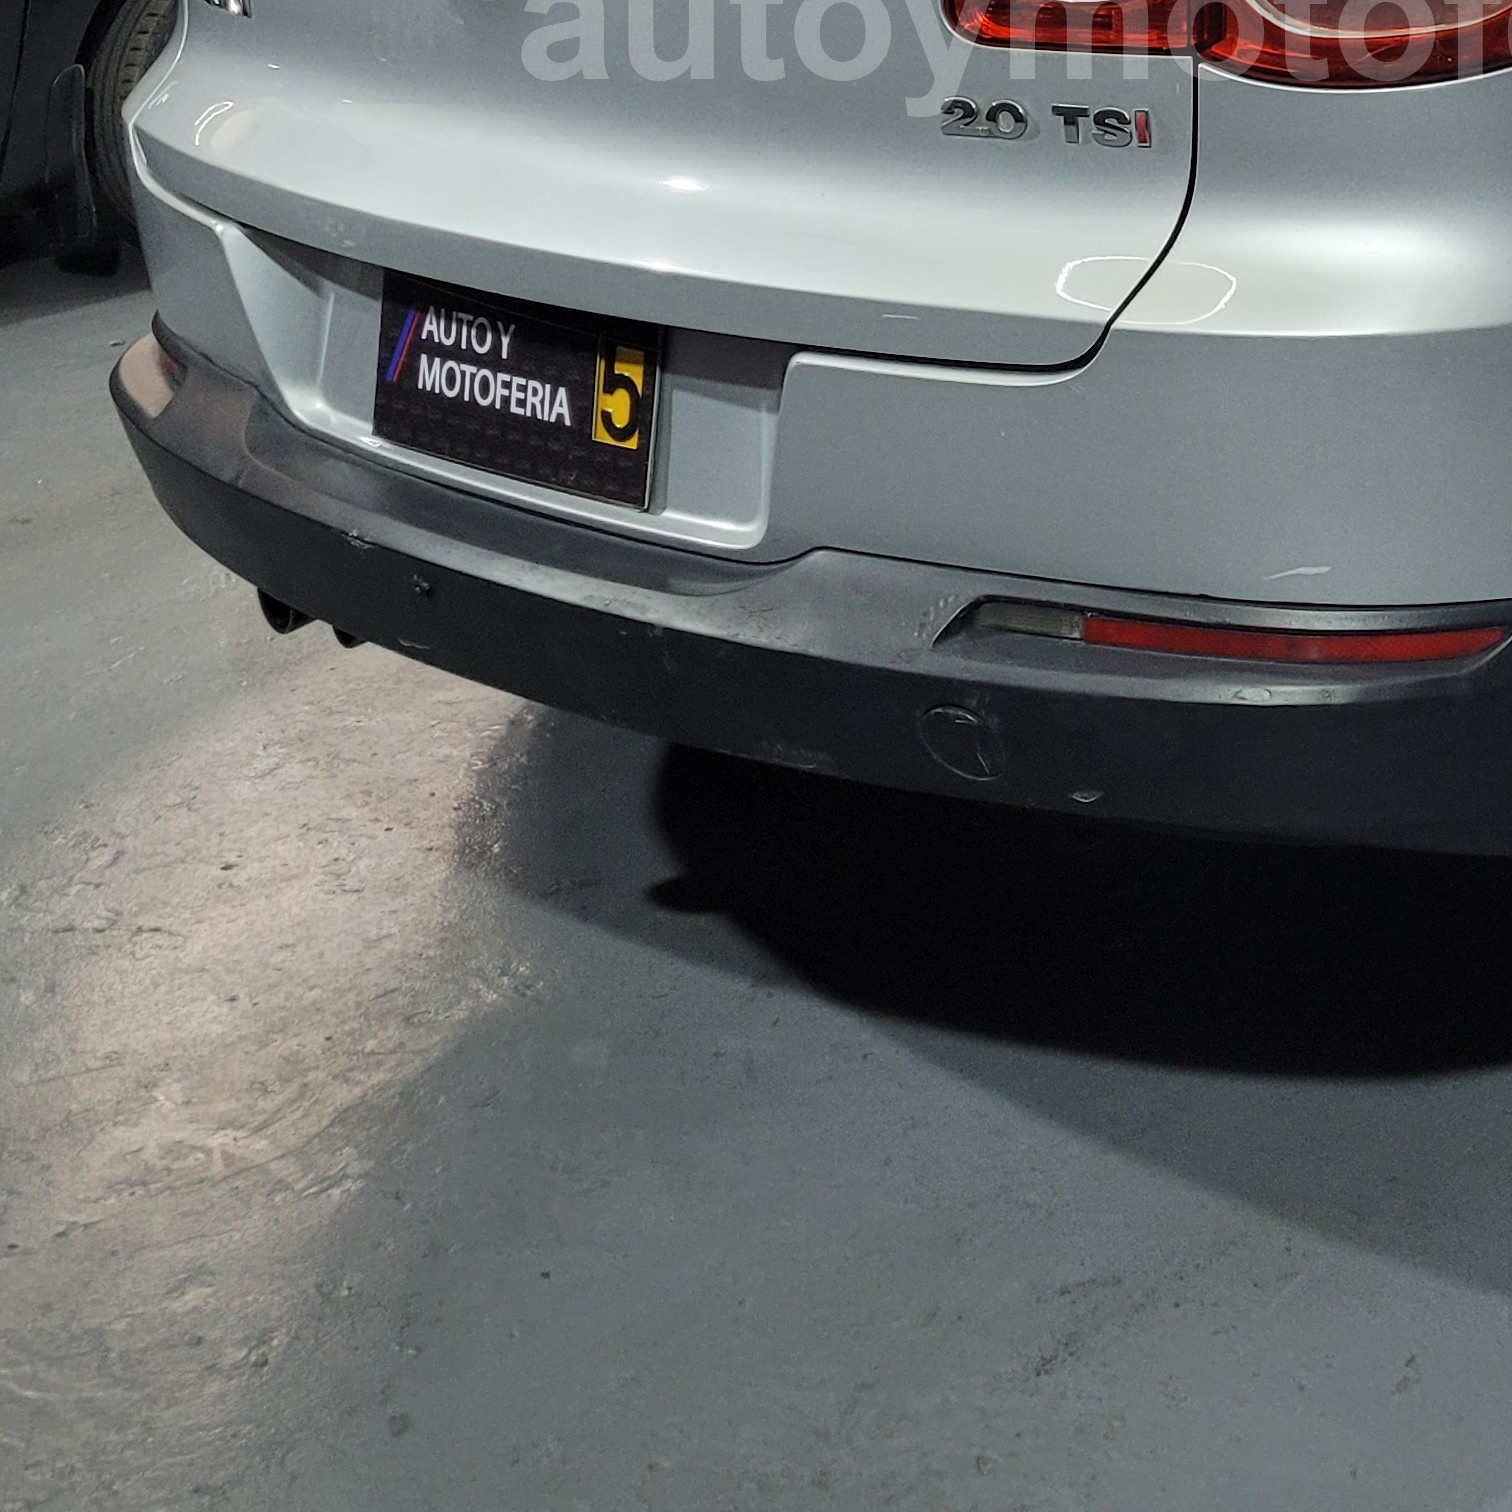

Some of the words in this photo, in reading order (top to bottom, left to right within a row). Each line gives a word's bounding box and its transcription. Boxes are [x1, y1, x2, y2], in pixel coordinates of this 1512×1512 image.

[420, 305, 493, 355] AUTO
[497, 320, 516, 360] Y
[417, 353, 572, 426] MOTOFERIA
